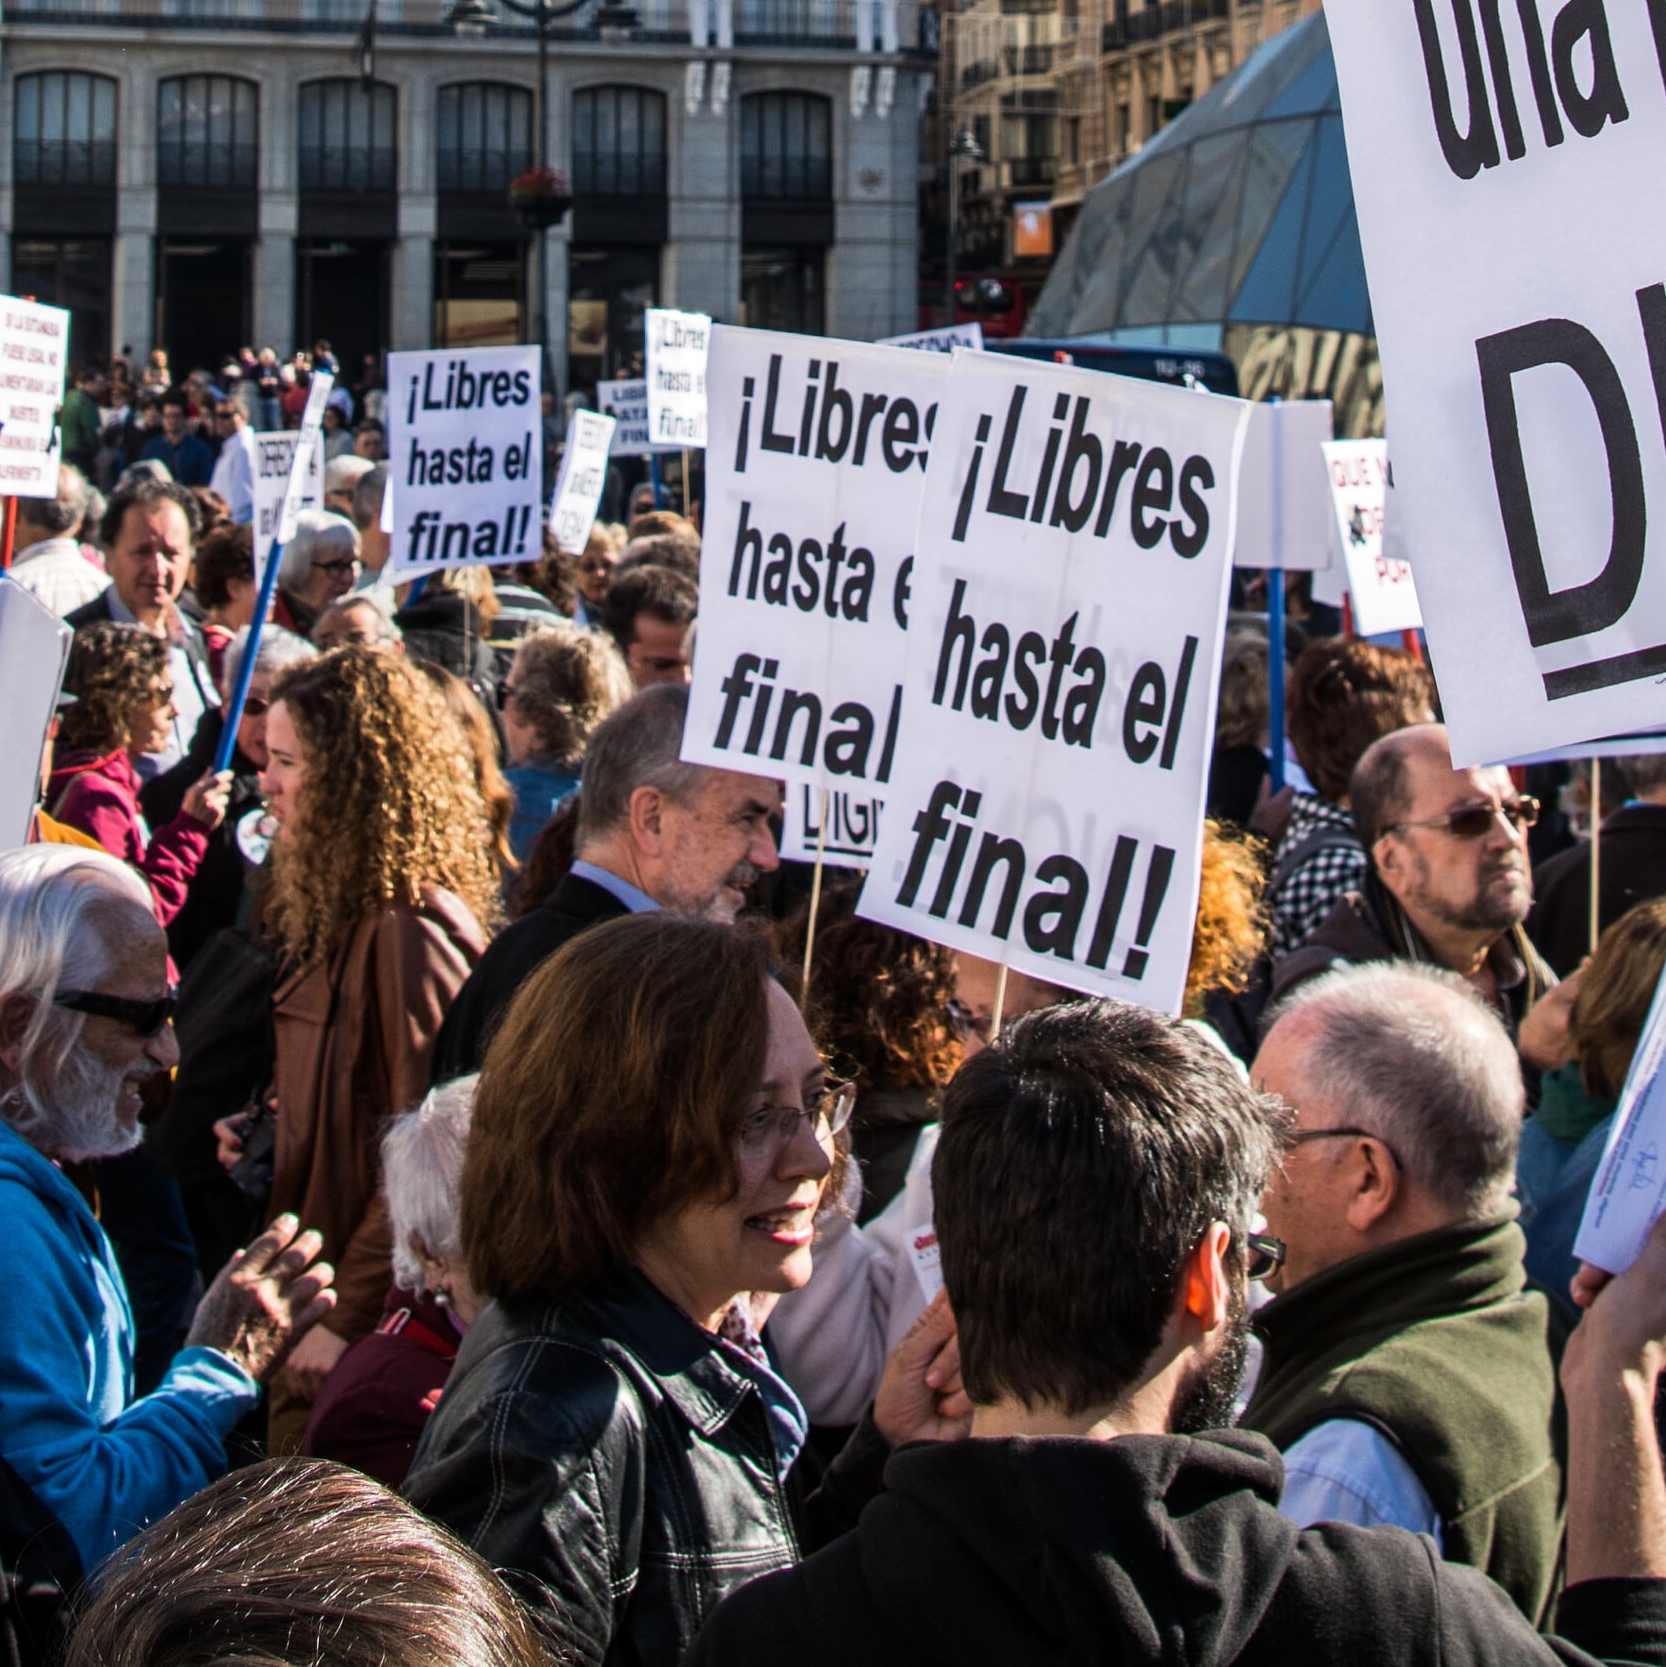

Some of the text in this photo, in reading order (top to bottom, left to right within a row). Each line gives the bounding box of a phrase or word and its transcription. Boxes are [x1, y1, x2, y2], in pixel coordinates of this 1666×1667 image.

[407, 362, 530, 424] ¡Libres
[407, 438, 492, 486] hasta
[502, 432, 532, 479] el
[952, 384, 1216, 559] ¡Libres
[407, 506, 531, 560] final!
[728, 501, 914, 631] hasta e
[933, 579, 1199, 770] hasta el
[895, 780, 1176, 980] final!
